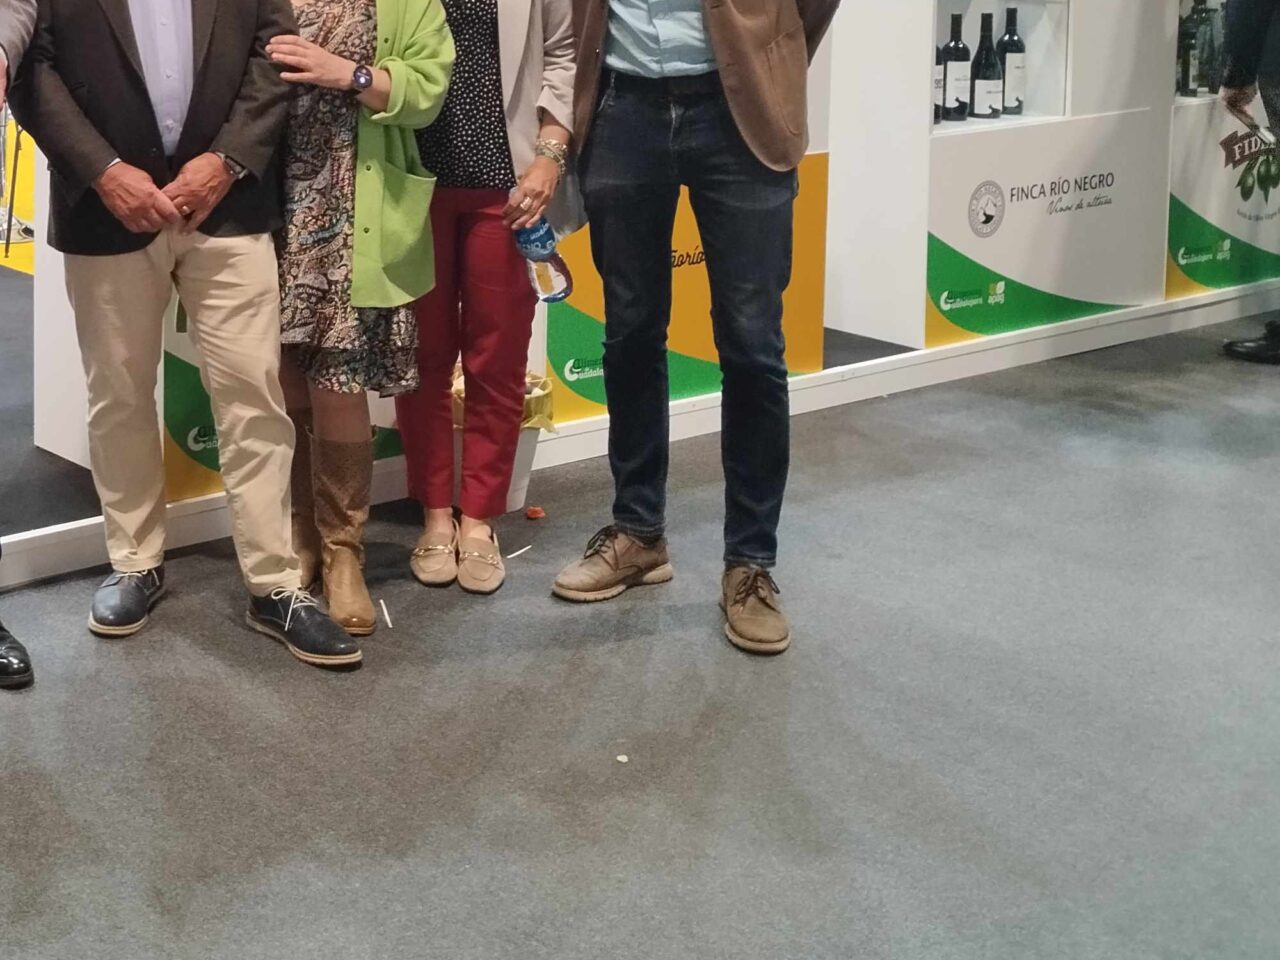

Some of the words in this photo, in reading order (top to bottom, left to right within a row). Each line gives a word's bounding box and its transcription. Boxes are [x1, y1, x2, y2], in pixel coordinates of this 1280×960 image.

[1009, 183, 1047, 203] FINCA
[1049, 176, 1070, 197] RÍO
[1073, 171, 1115, 192] NEGRO
